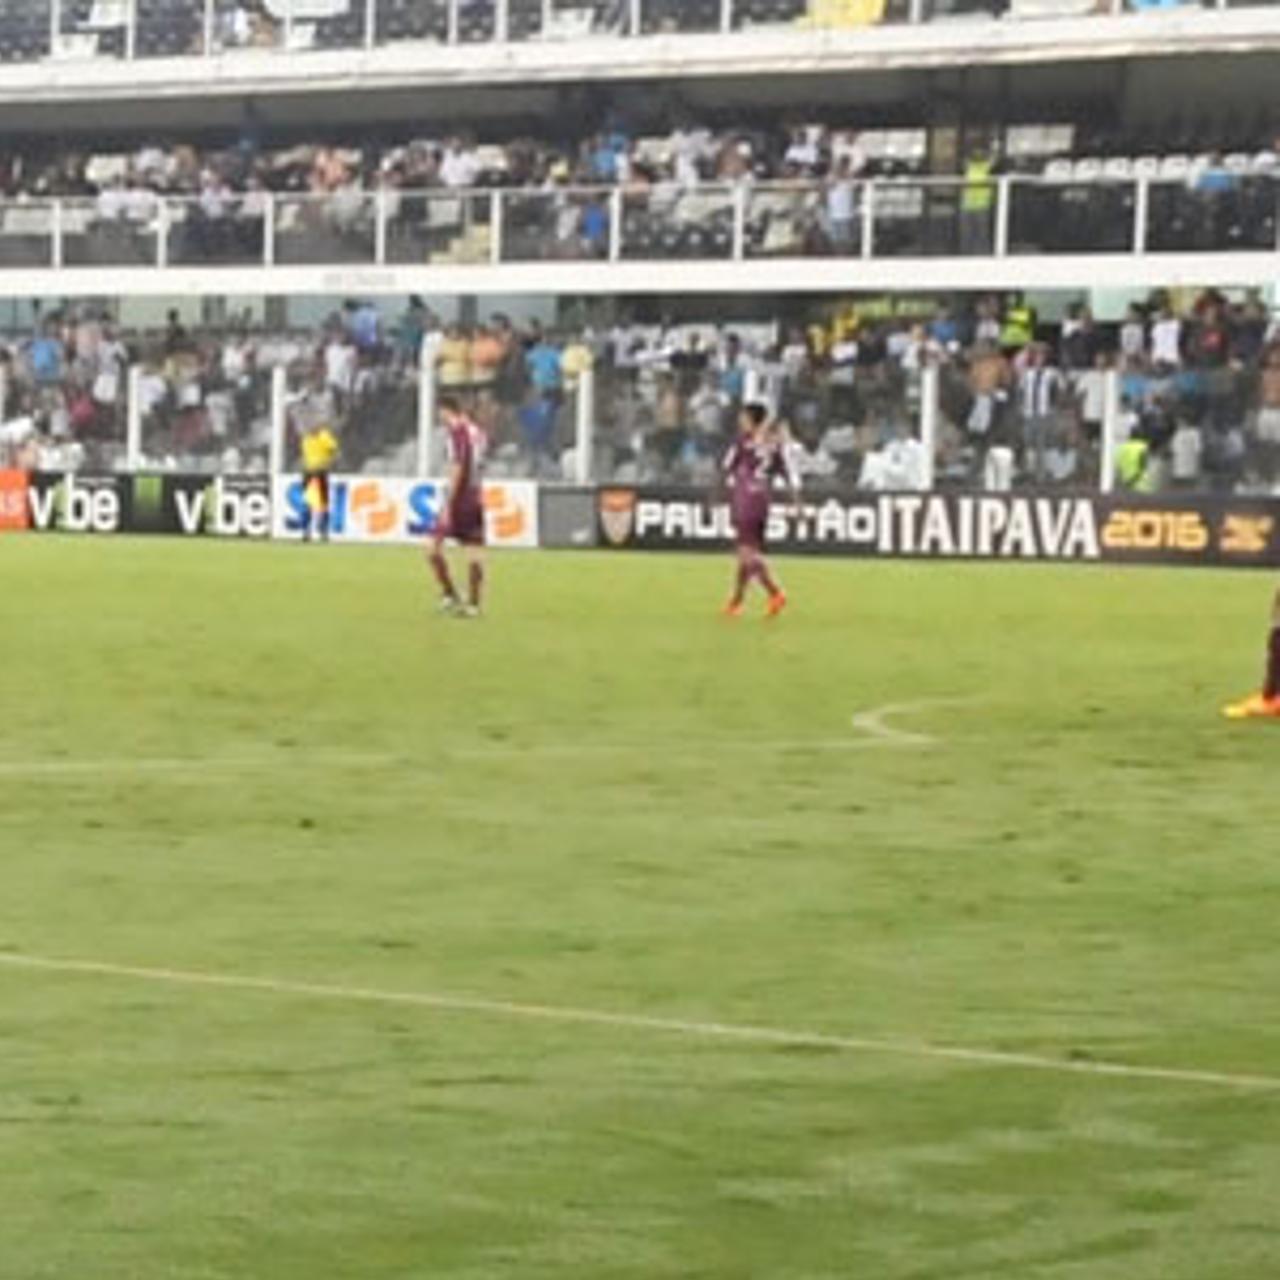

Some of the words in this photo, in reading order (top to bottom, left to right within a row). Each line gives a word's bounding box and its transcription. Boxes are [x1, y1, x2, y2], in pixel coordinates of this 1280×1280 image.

[635, 499, 878, 543] PAULSTÃO
[877, 494, 1100, 557] ITAIPAVA
[1102, 511, 1209, 550] 2016
